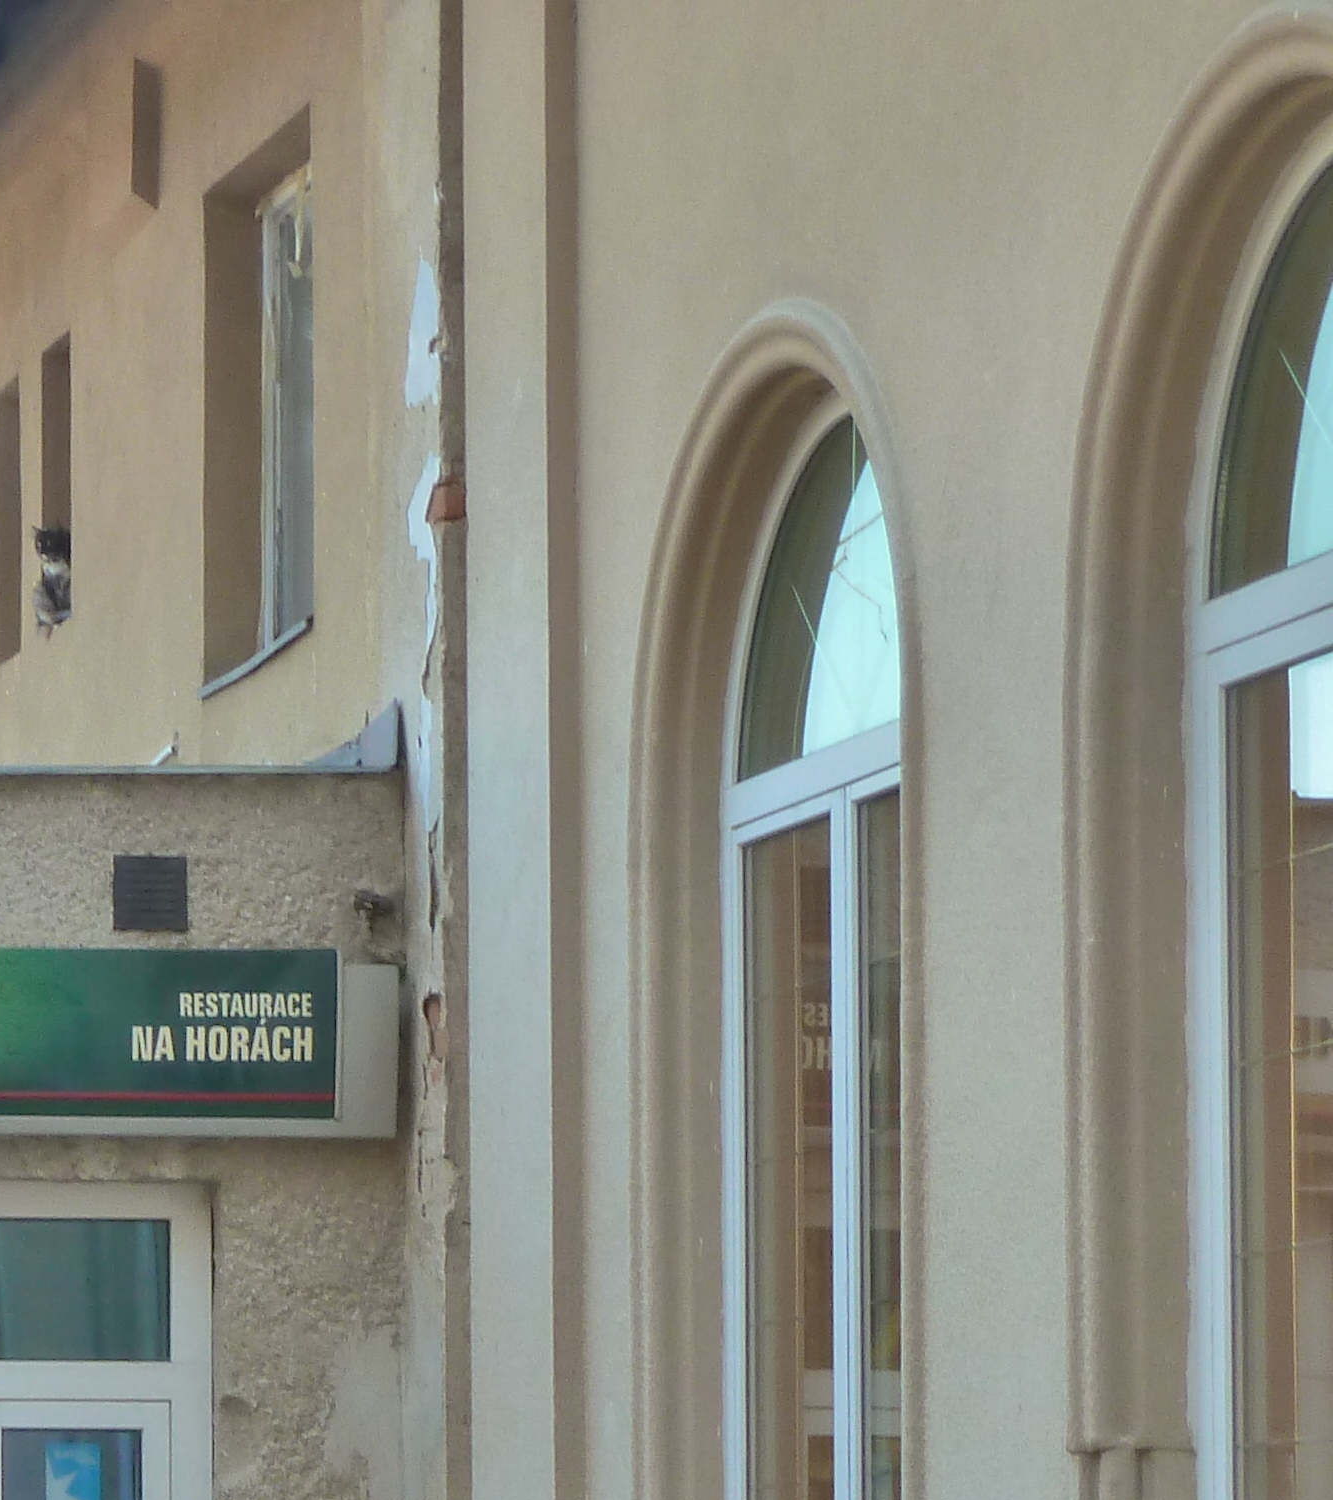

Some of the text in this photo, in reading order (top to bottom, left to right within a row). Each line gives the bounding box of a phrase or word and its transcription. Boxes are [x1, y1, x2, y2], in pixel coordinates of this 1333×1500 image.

[179, 991, 313, 1018] RESTAURACE
[131, 1017, 314, 1062] NA HORÁCH
